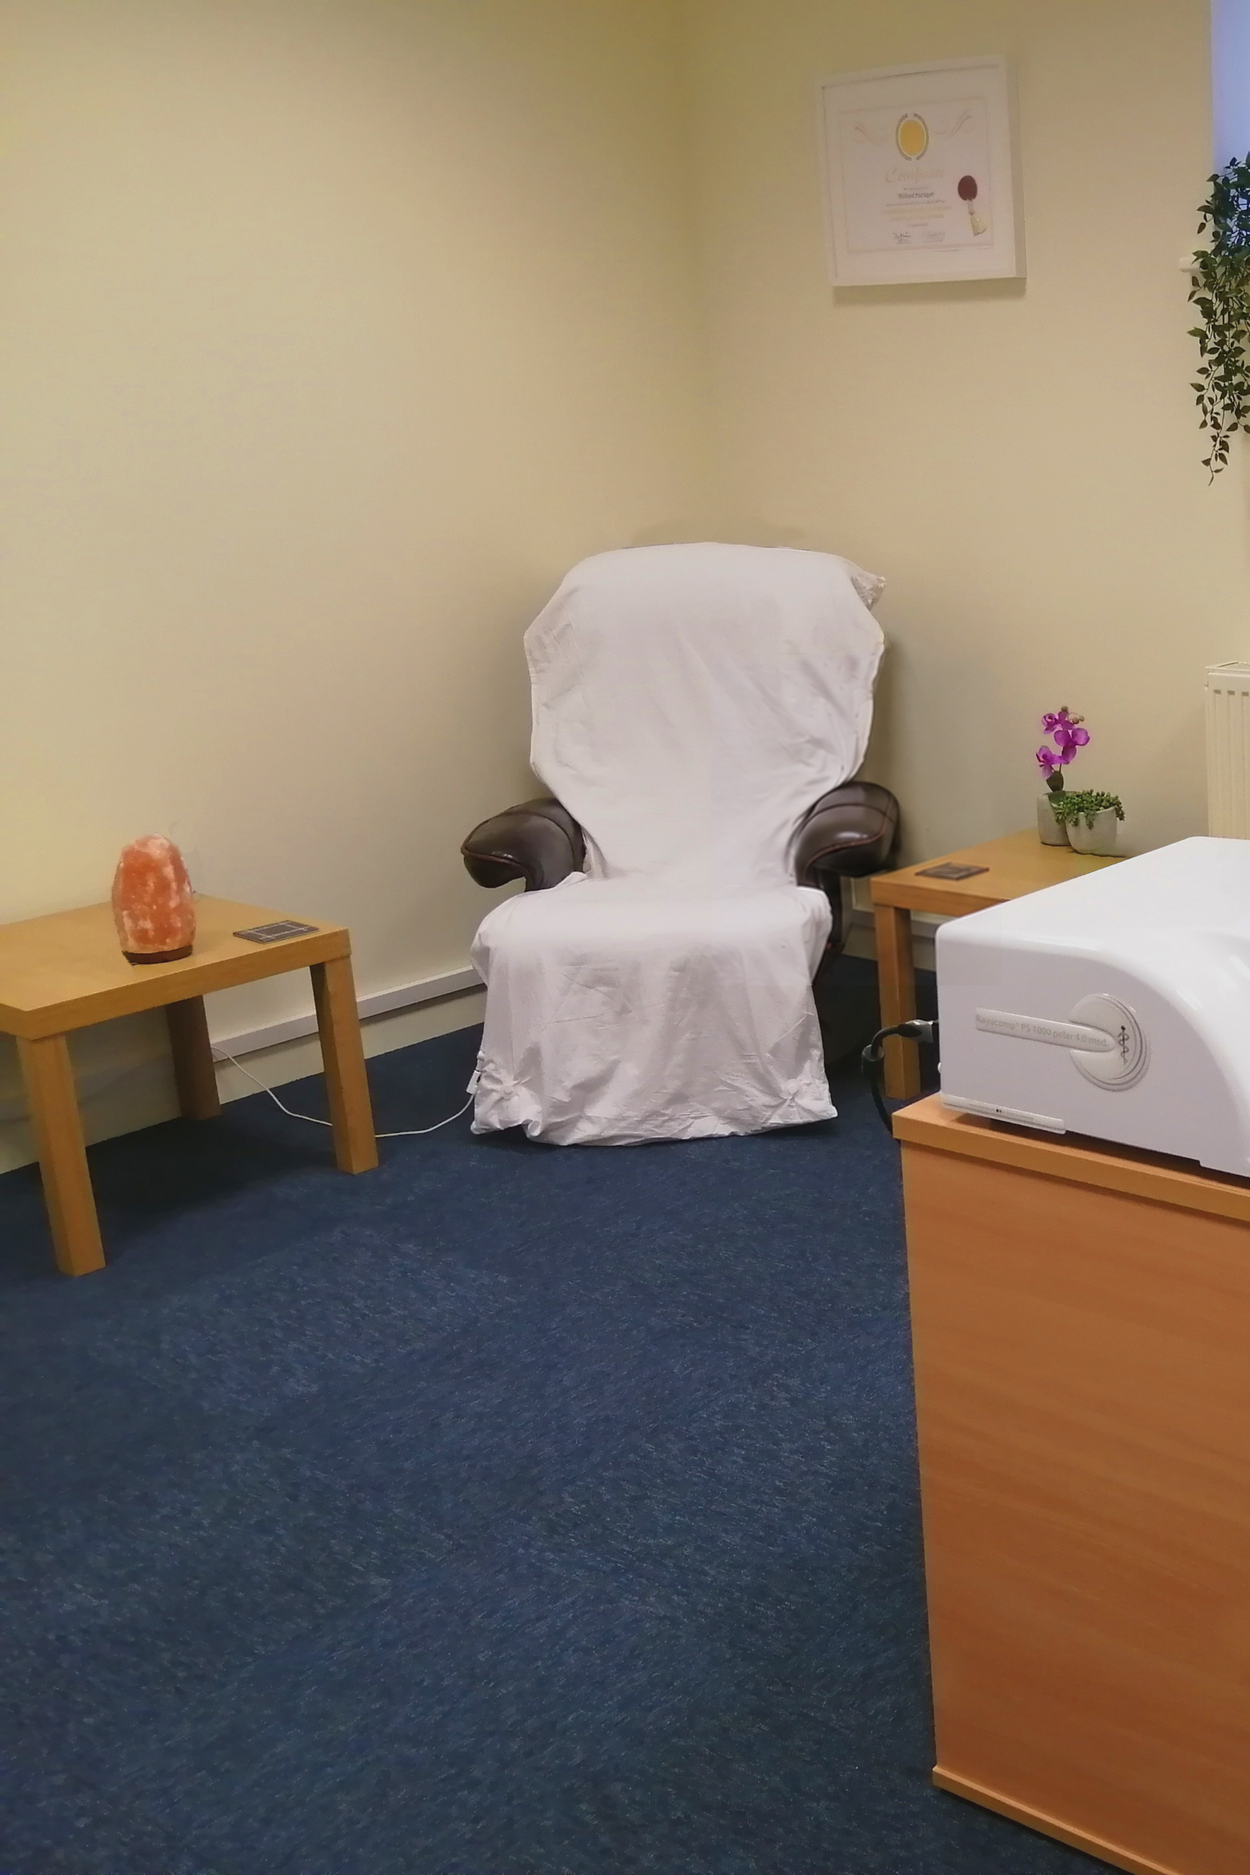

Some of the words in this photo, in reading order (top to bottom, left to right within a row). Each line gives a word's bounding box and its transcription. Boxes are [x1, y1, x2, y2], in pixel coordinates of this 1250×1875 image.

[1021, 1023, 1031, 1033] PS
[1033, 1025, 1052, 1036] 1000
[1052, 1029, 1074, 1041] polar
[1075, 1034, 1087, 1044] 4.0
